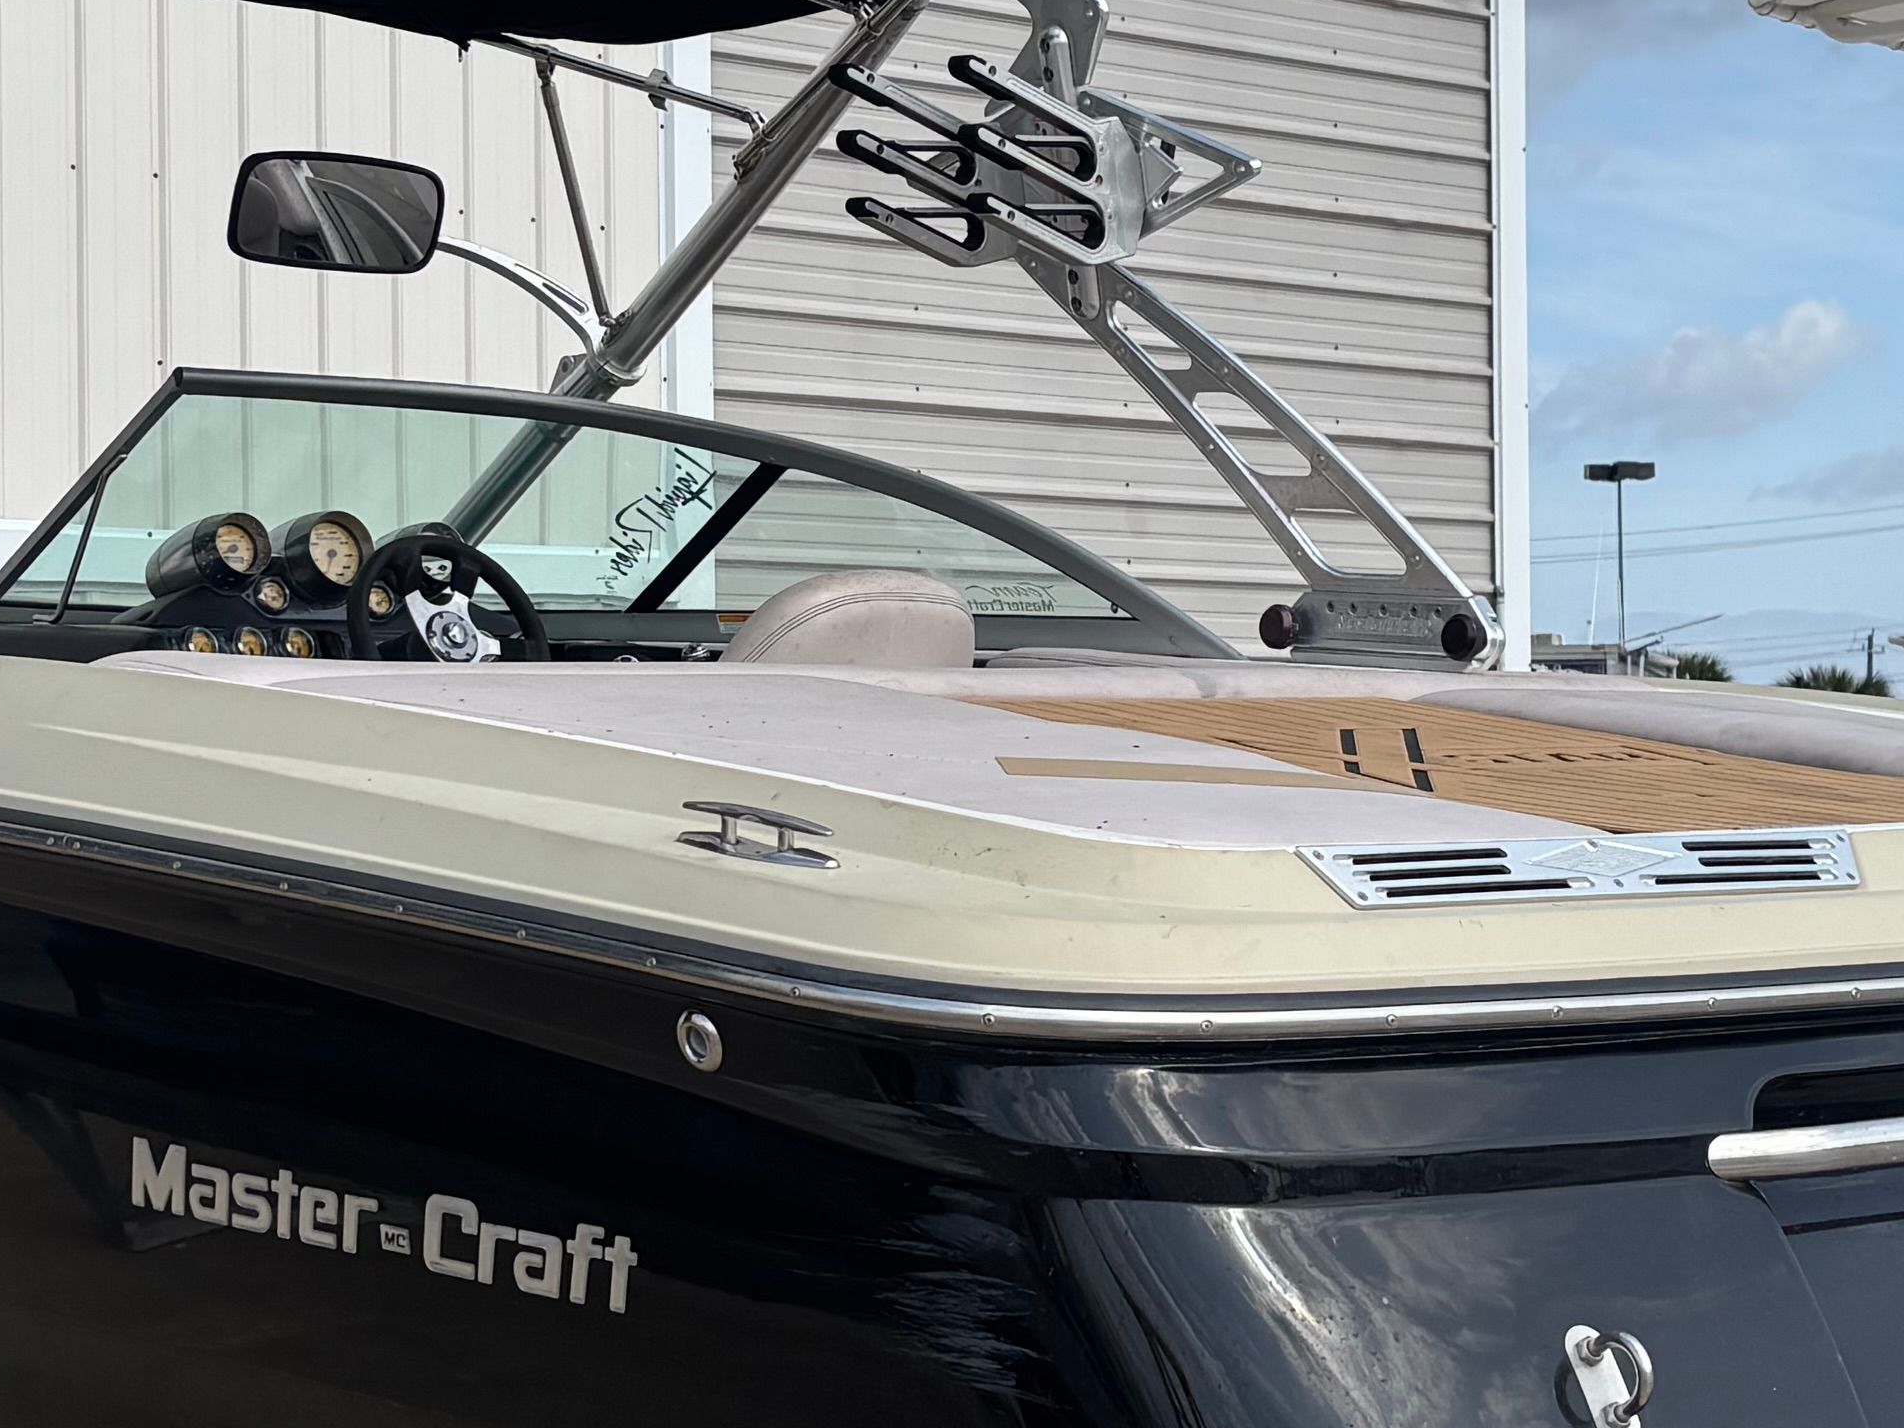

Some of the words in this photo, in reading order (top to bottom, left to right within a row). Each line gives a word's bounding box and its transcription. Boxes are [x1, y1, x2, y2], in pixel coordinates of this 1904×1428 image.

[131, 1136, 378, 1254] Master
[383, 1230, 407, 1249] MC
[423, 1193, 638, 1314] Craft
